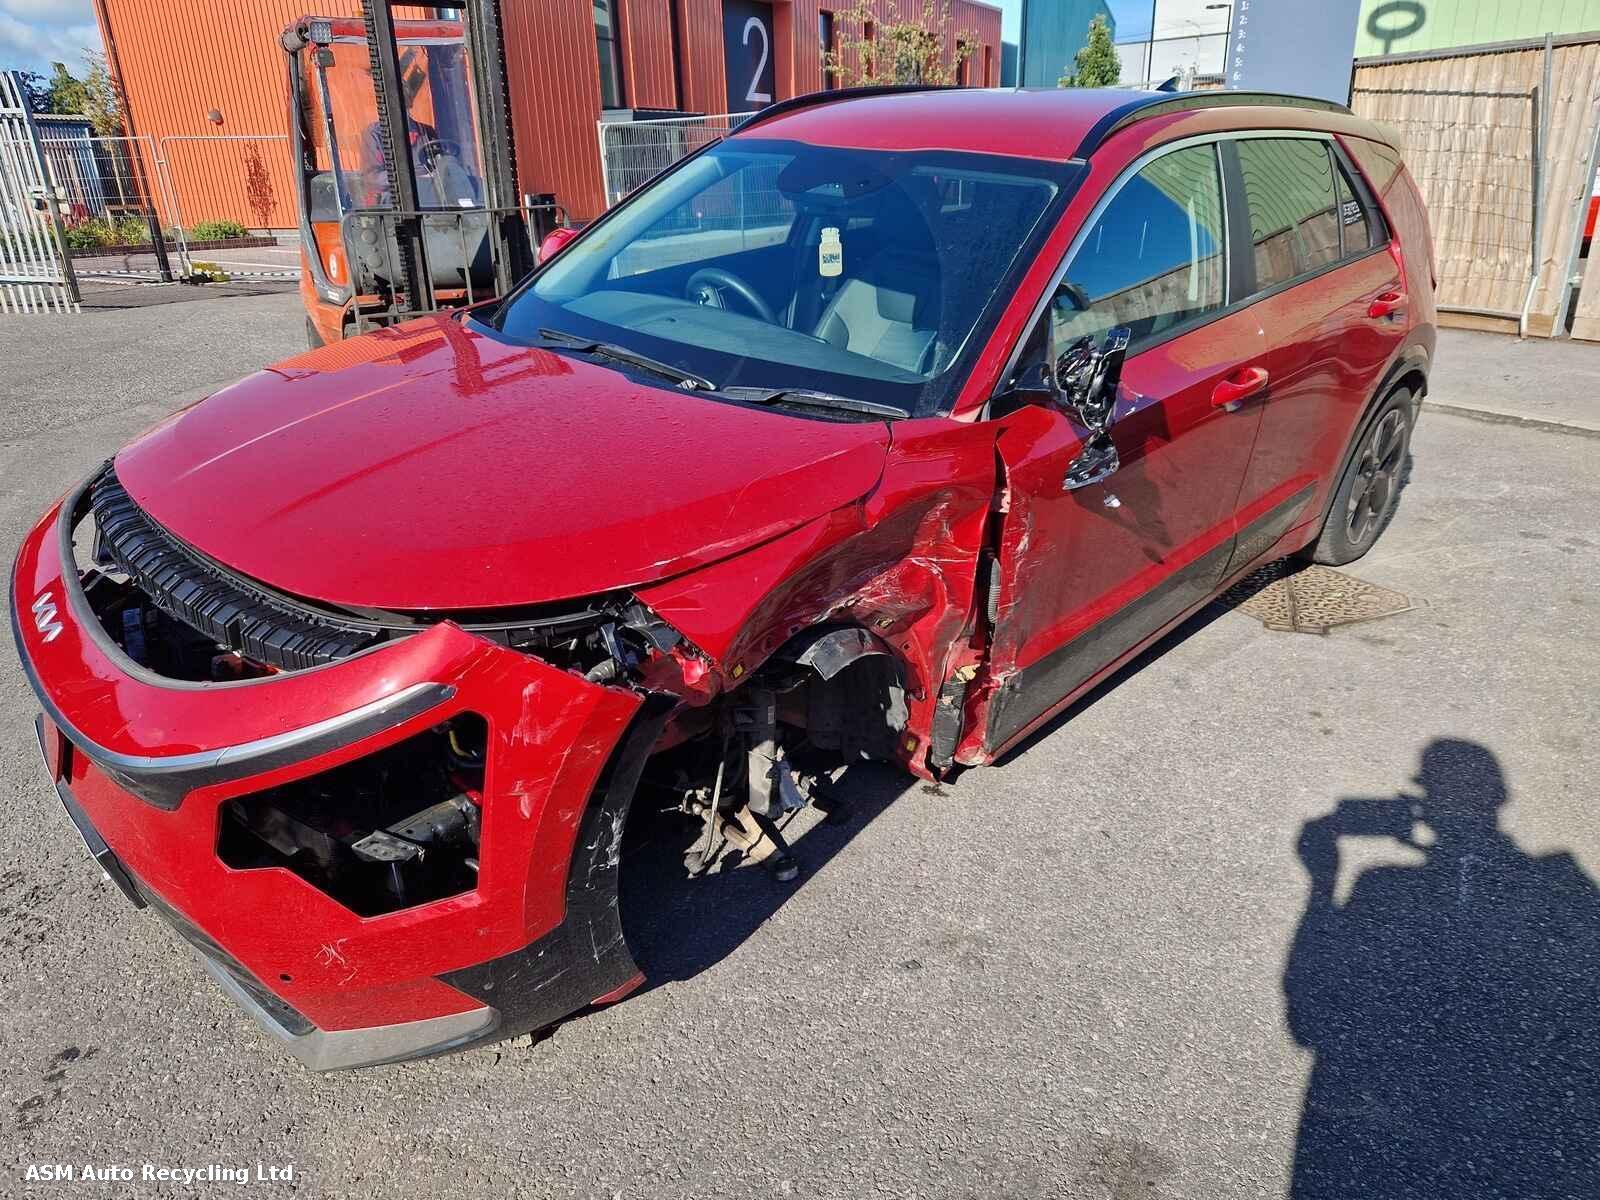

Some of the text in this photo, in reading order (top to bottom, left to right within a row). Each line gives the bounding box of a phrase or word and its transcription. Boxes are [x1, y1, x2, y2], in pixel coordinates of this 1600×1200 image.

[1239, 15, 1248, 25] 2:
[1238, 29, 1246, 39] 3:
[743, 16, 771, 102] 2
[1233, 71, 1241, 80] 6:
